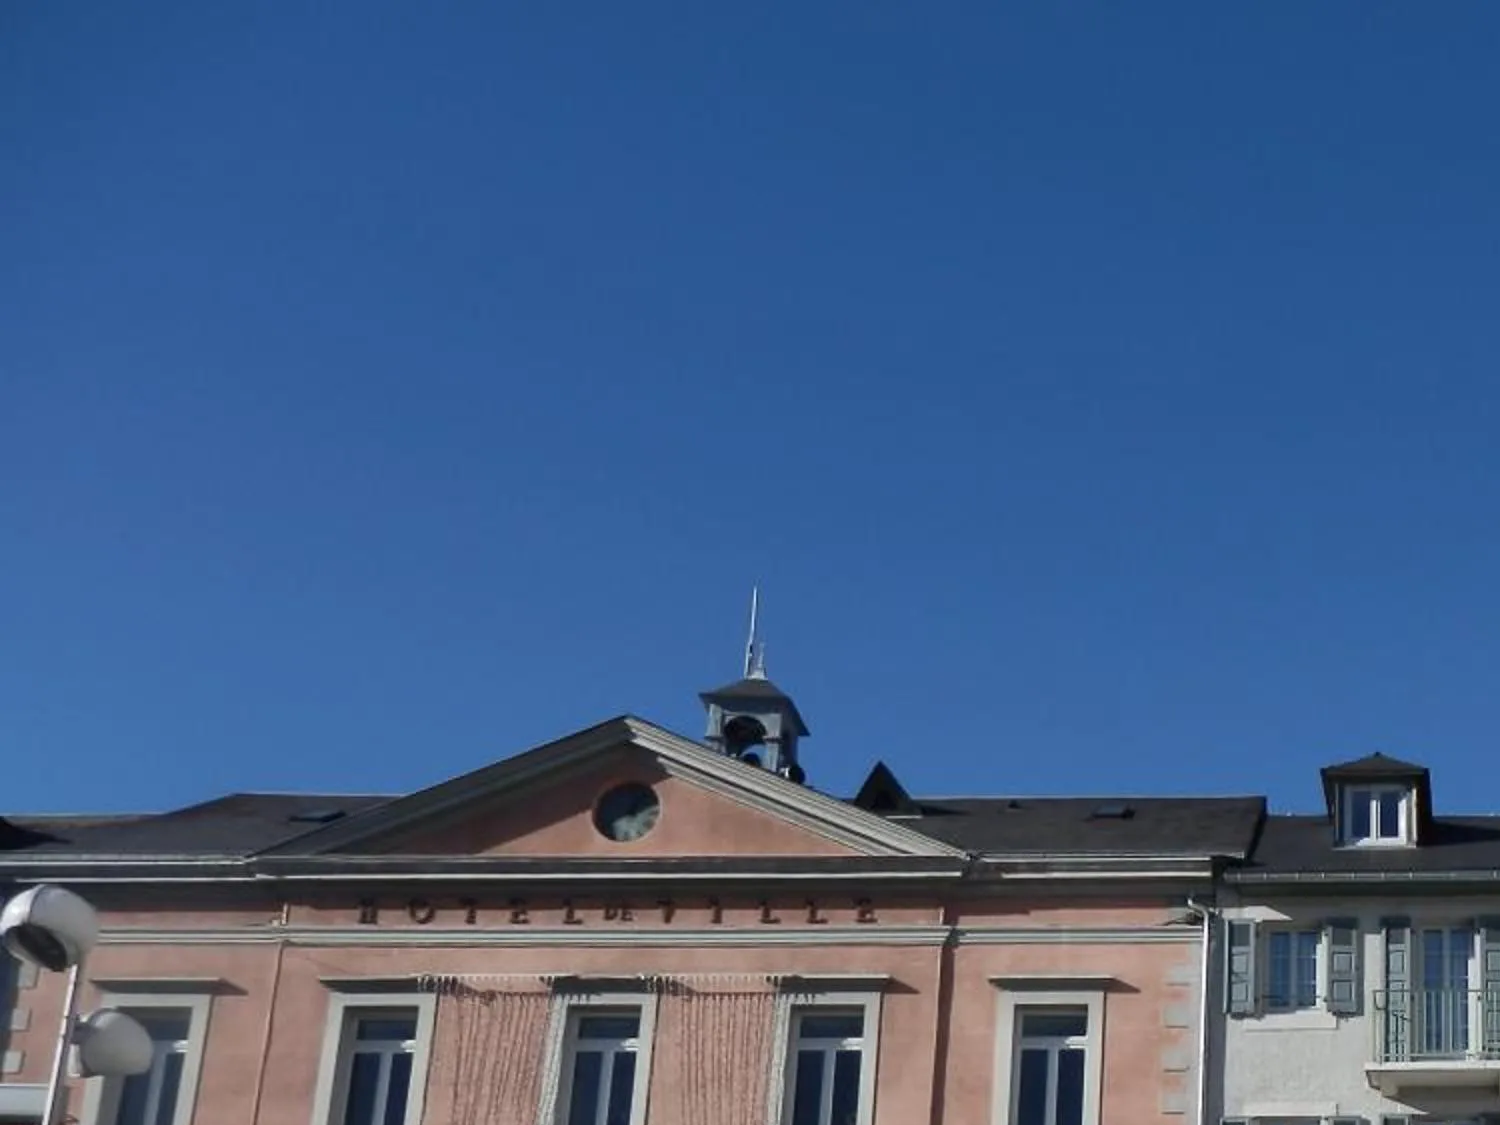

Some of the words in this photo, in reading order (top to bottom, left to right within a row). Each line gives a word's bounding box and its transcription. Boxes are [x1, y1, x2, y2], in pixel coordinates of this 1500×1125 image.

[358, 898, 583, 925] HOTEL
[603, 905, 635, 922] DE
[657, 898, 878, 925] VILLE
